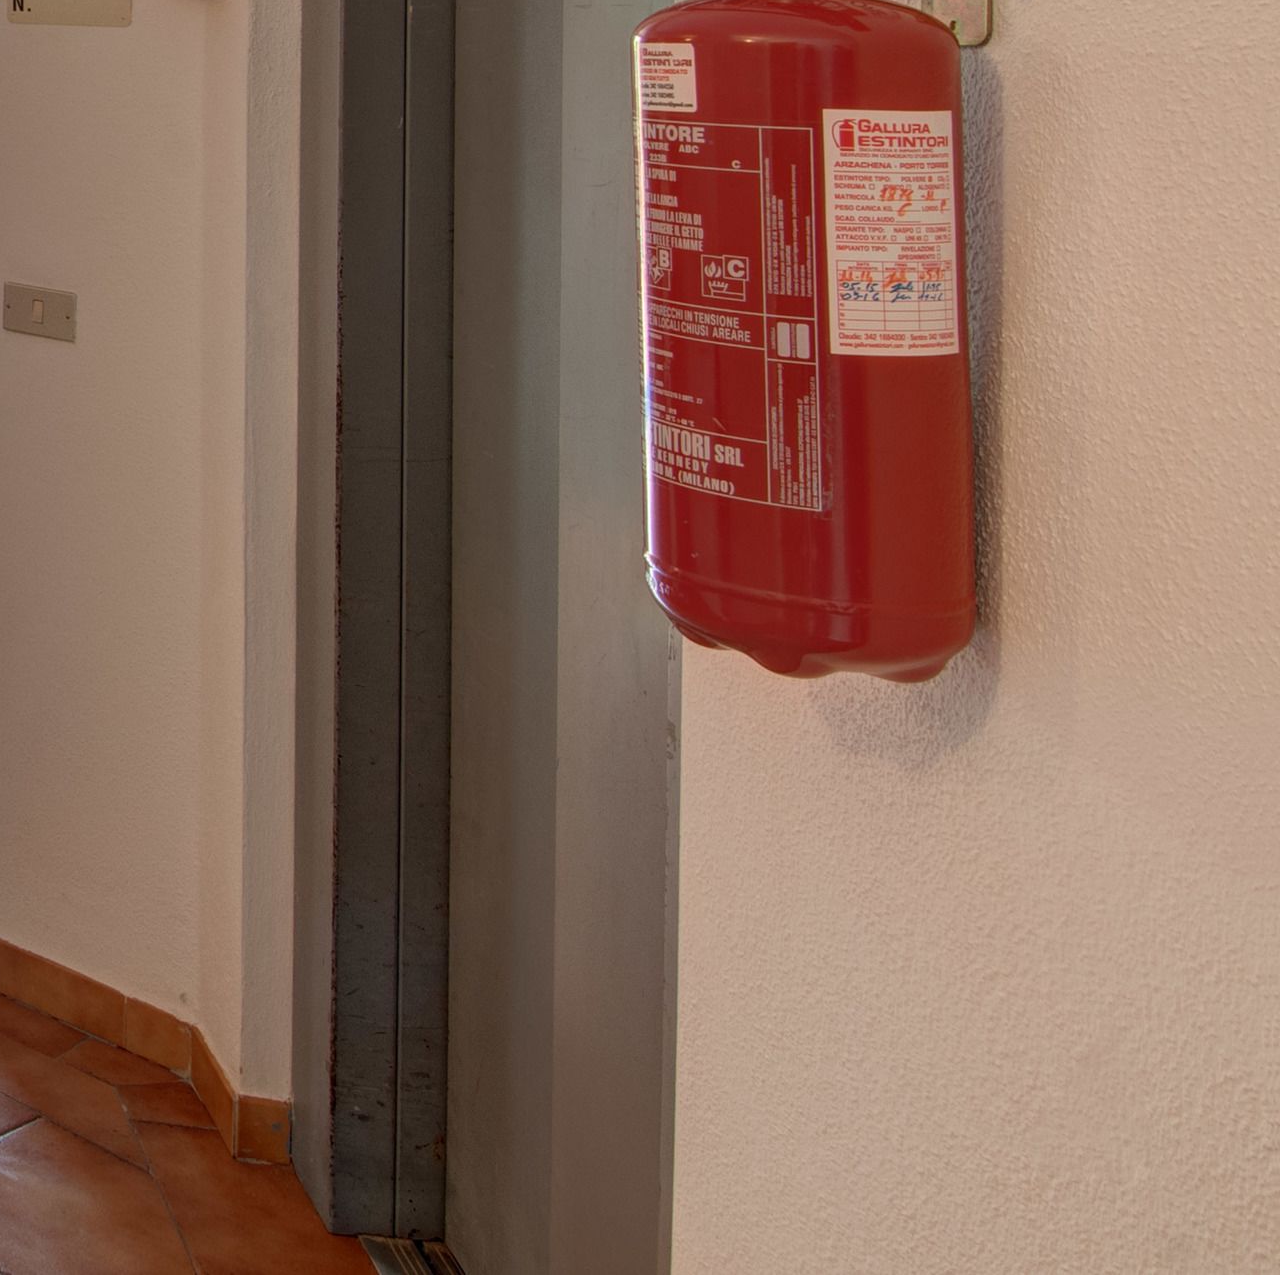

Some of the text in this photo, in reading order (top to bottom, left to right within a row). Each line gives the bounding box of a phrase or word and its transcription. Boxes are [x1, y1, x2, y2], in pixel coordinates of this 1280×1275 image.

[858, 119, 930, 135] GALLURA
[678, 144, 700, 154] ABC
[857, 135, 949, 148] ESTINTORI
[730, 159, 742, 169] C
[834, 161, 892, 169] ARZACHENA
[834, 174, 873, 182] ESTINTORE
[671, 236, 704, 252] FIAMME
[659, 249, 669, 268] B
[726, 259, 746, 278] C
[693, 311, 740, 329] TENSIONE
[658, 317, 681, 331] LOCALI
[681, 320, 709, 337] CHIUSI
[712, 328, 752, 343] AREARE
[657, 448, 709, 474] KENNEDY
[714, 443, 744, 468] SRL
[678, 469, 735, 495] (MILANO)
